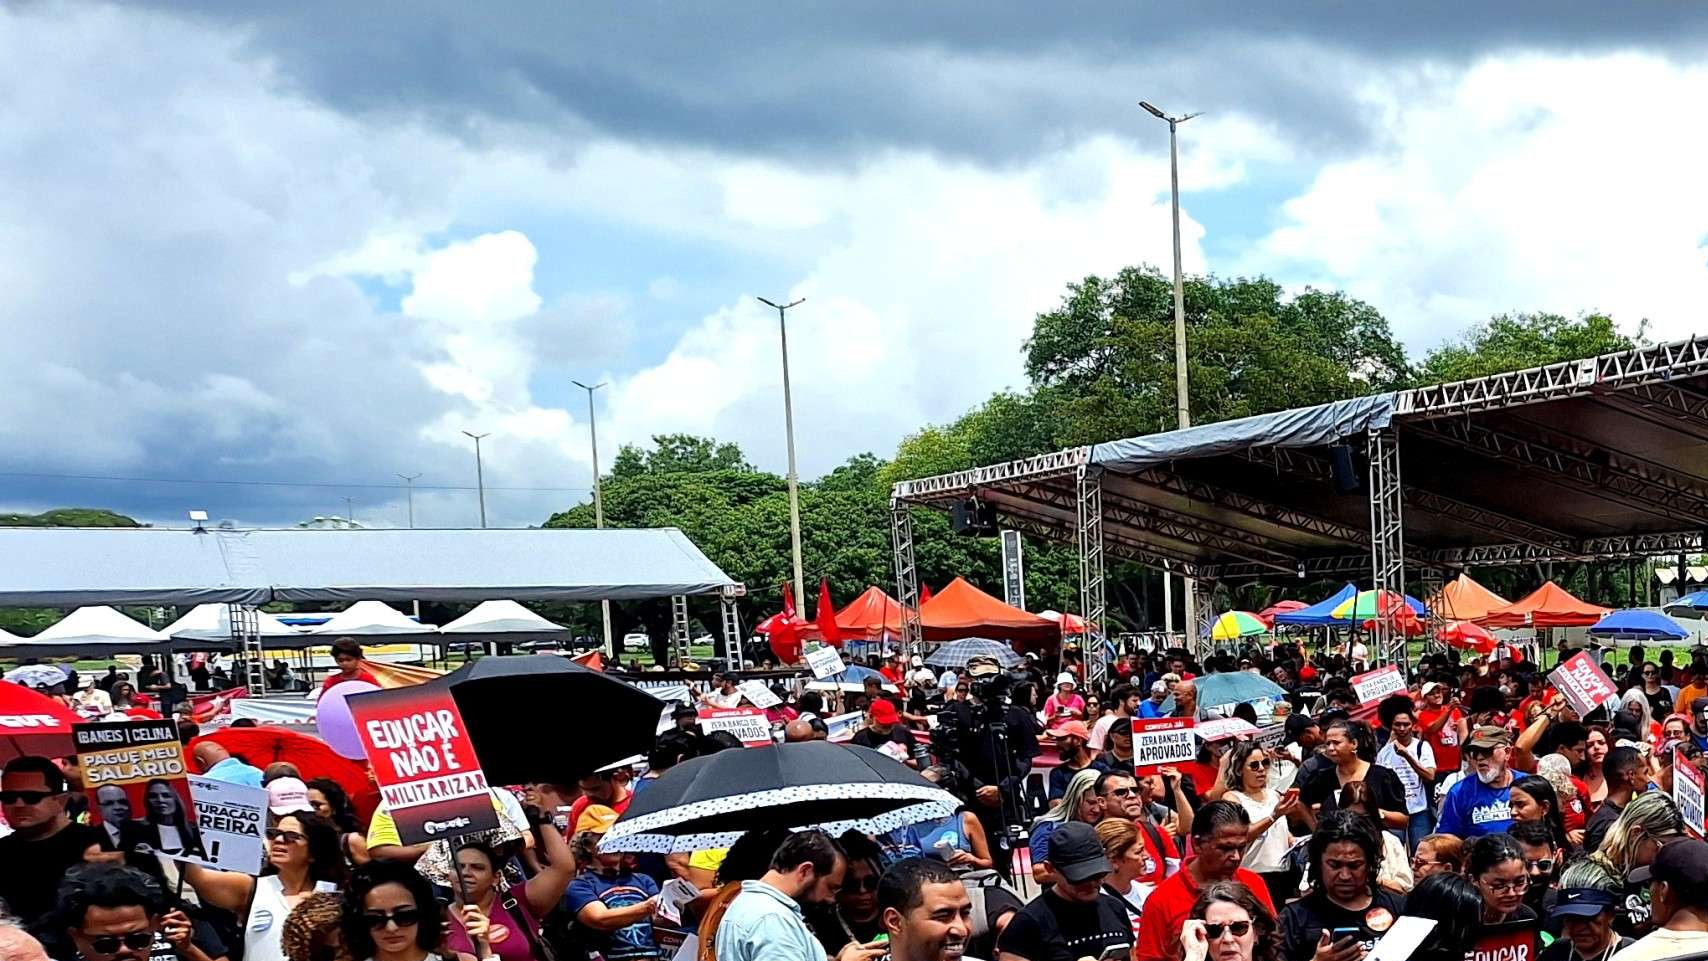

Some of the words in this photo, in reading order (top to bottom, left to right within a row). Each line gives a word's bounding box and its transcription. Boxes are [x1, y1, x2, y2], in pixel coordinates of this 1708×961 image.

[132, 727, 174, 741] CELINA
[366, 709, 459, 749] EDUCAR
[1142, 735, 1158, 746] ZERA
[1158, 733, 1181, 745] BANCO
[1181, 732, 1188, 742] DE
[83, 750, 141, 768] PAGUE
[141, 747, 179, 761] MEU
[390, 743, 441, 778] NÃO
[442, 738, 461, 770] É
[1140, 744, 1192, 762] APROVADOS
[88, 756, 183, 783] SALÁRIO
[384, 774, 488, 807] MILITARIZAR
